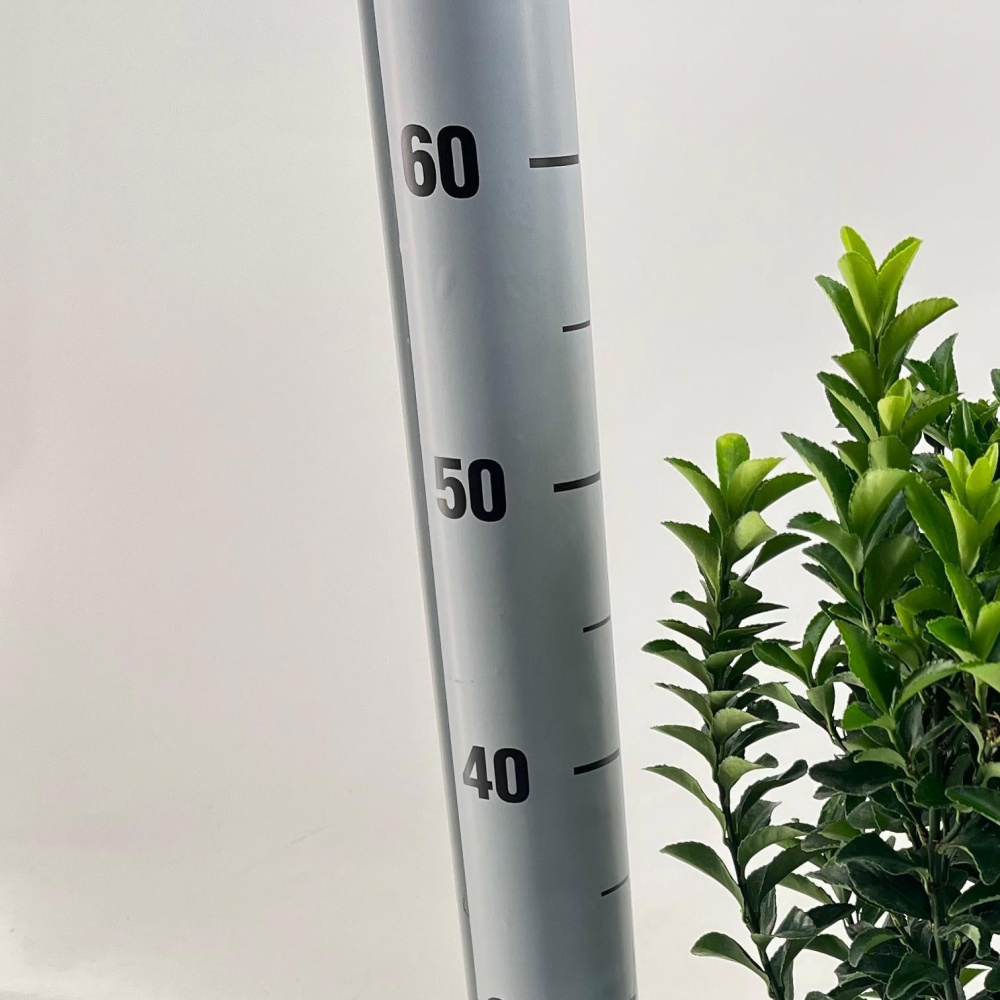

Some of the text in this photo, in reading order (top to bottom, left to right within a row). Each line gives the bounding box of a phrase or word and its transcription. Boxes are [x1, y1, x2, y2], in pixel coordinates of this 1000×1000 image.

[400, 124, 480, 198] 60
[433, 456, 507, 522] 50
[462, 745, 530, 804] 40
